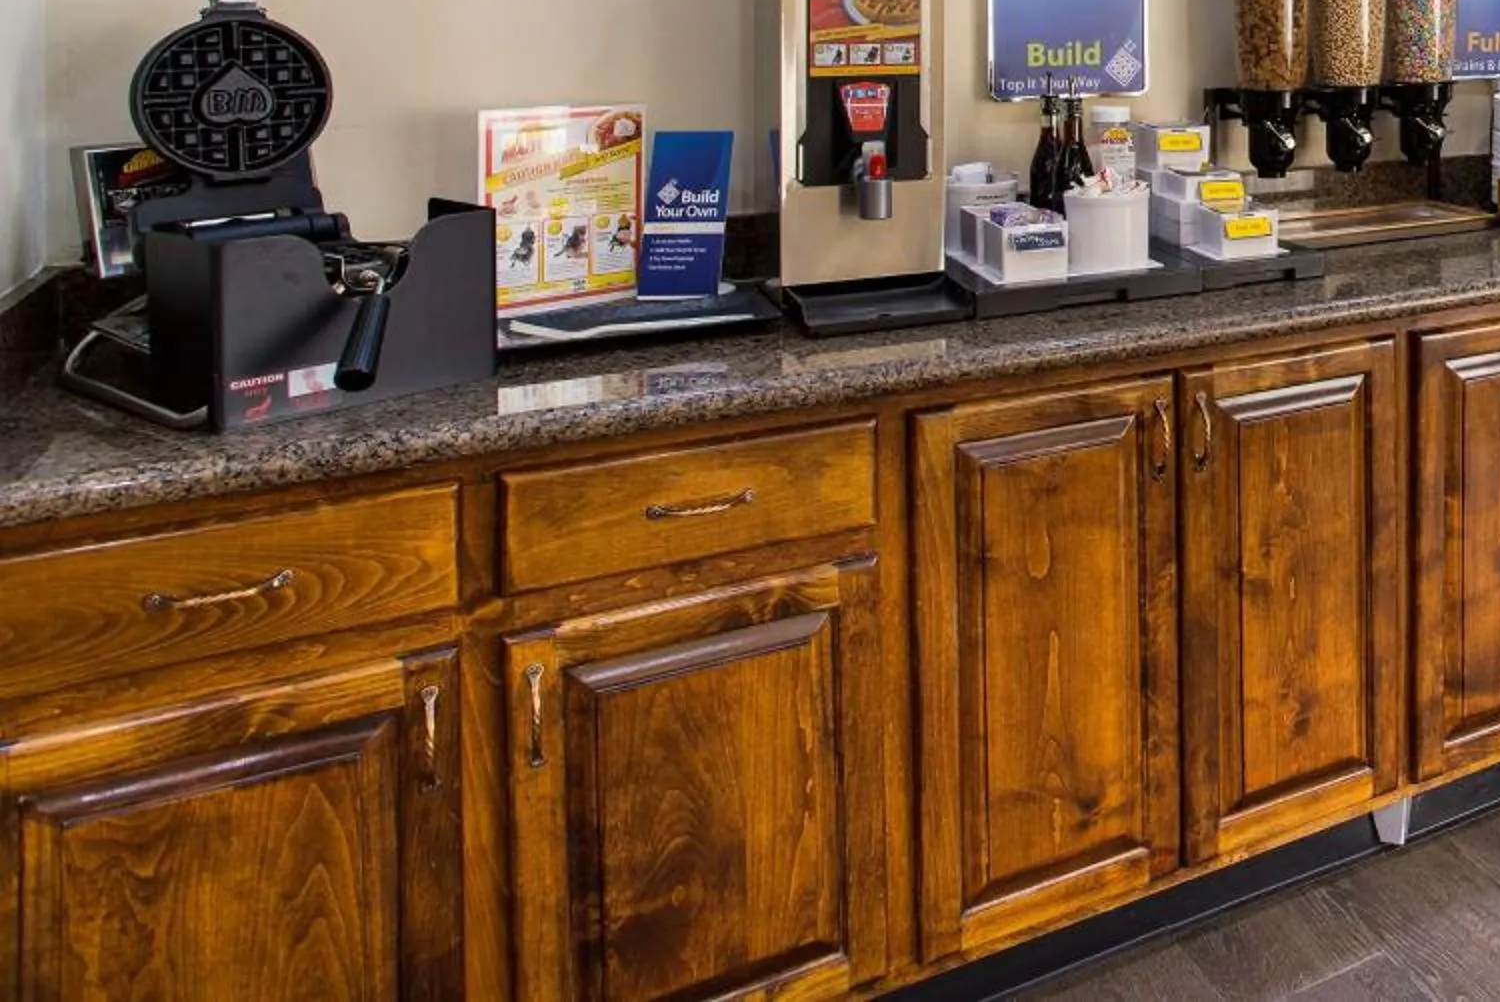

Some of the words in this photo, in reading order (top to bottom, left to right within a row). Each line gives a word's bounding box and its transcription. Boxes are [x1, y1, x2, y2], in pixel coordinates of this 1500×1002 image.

[1026, 40, 1101, 68] Build
[1487, 59, 1497, 71] &
[1001, 78, 1025, 94] Top
[208, 87, 267, 116] BM
[681, 188, 721, 204] Build
[655, 204, 685, 218] Your
[686, 204, 718, 218] Own
[229, 373, 285, 391] CAUTION
